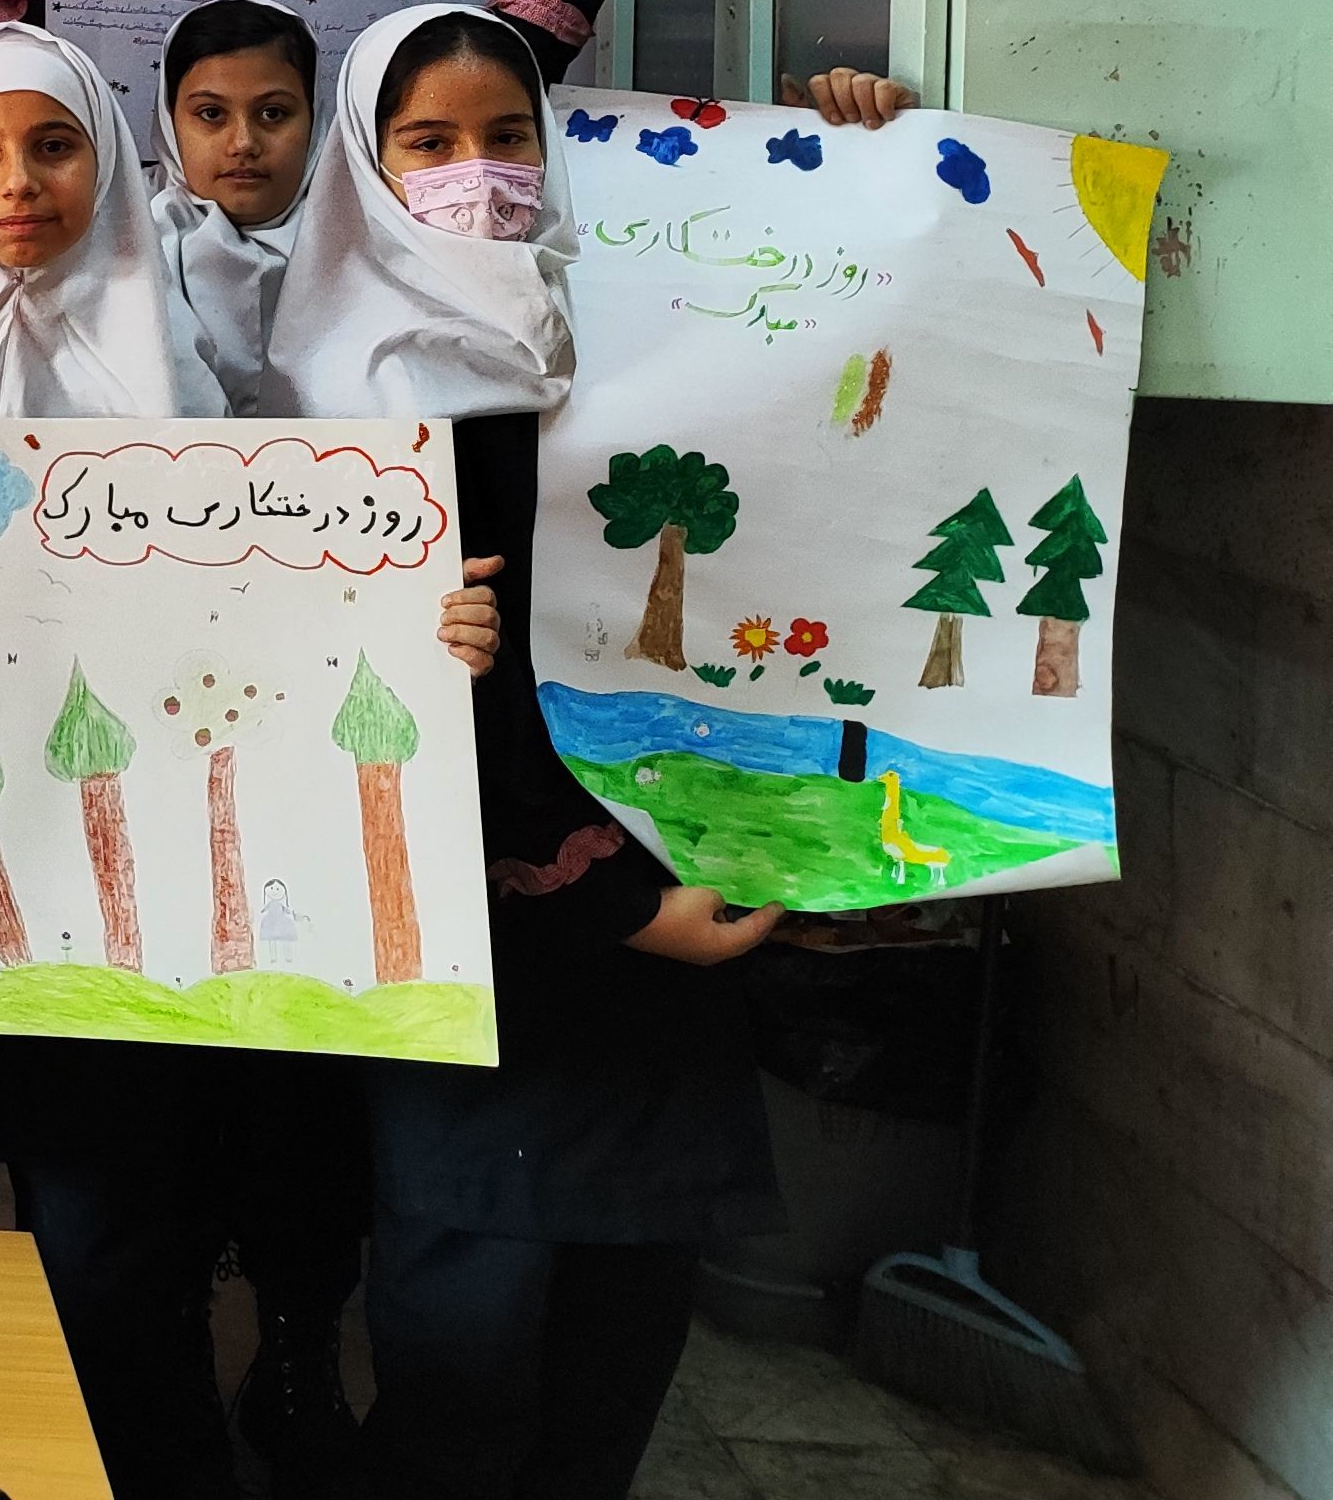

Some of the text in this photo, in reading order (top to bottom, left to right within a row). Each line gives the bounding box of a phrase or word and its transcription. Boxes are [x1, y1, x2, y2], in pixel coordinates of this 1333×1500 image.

[42, 467, 423, 542] روز درختکاری مبارک
